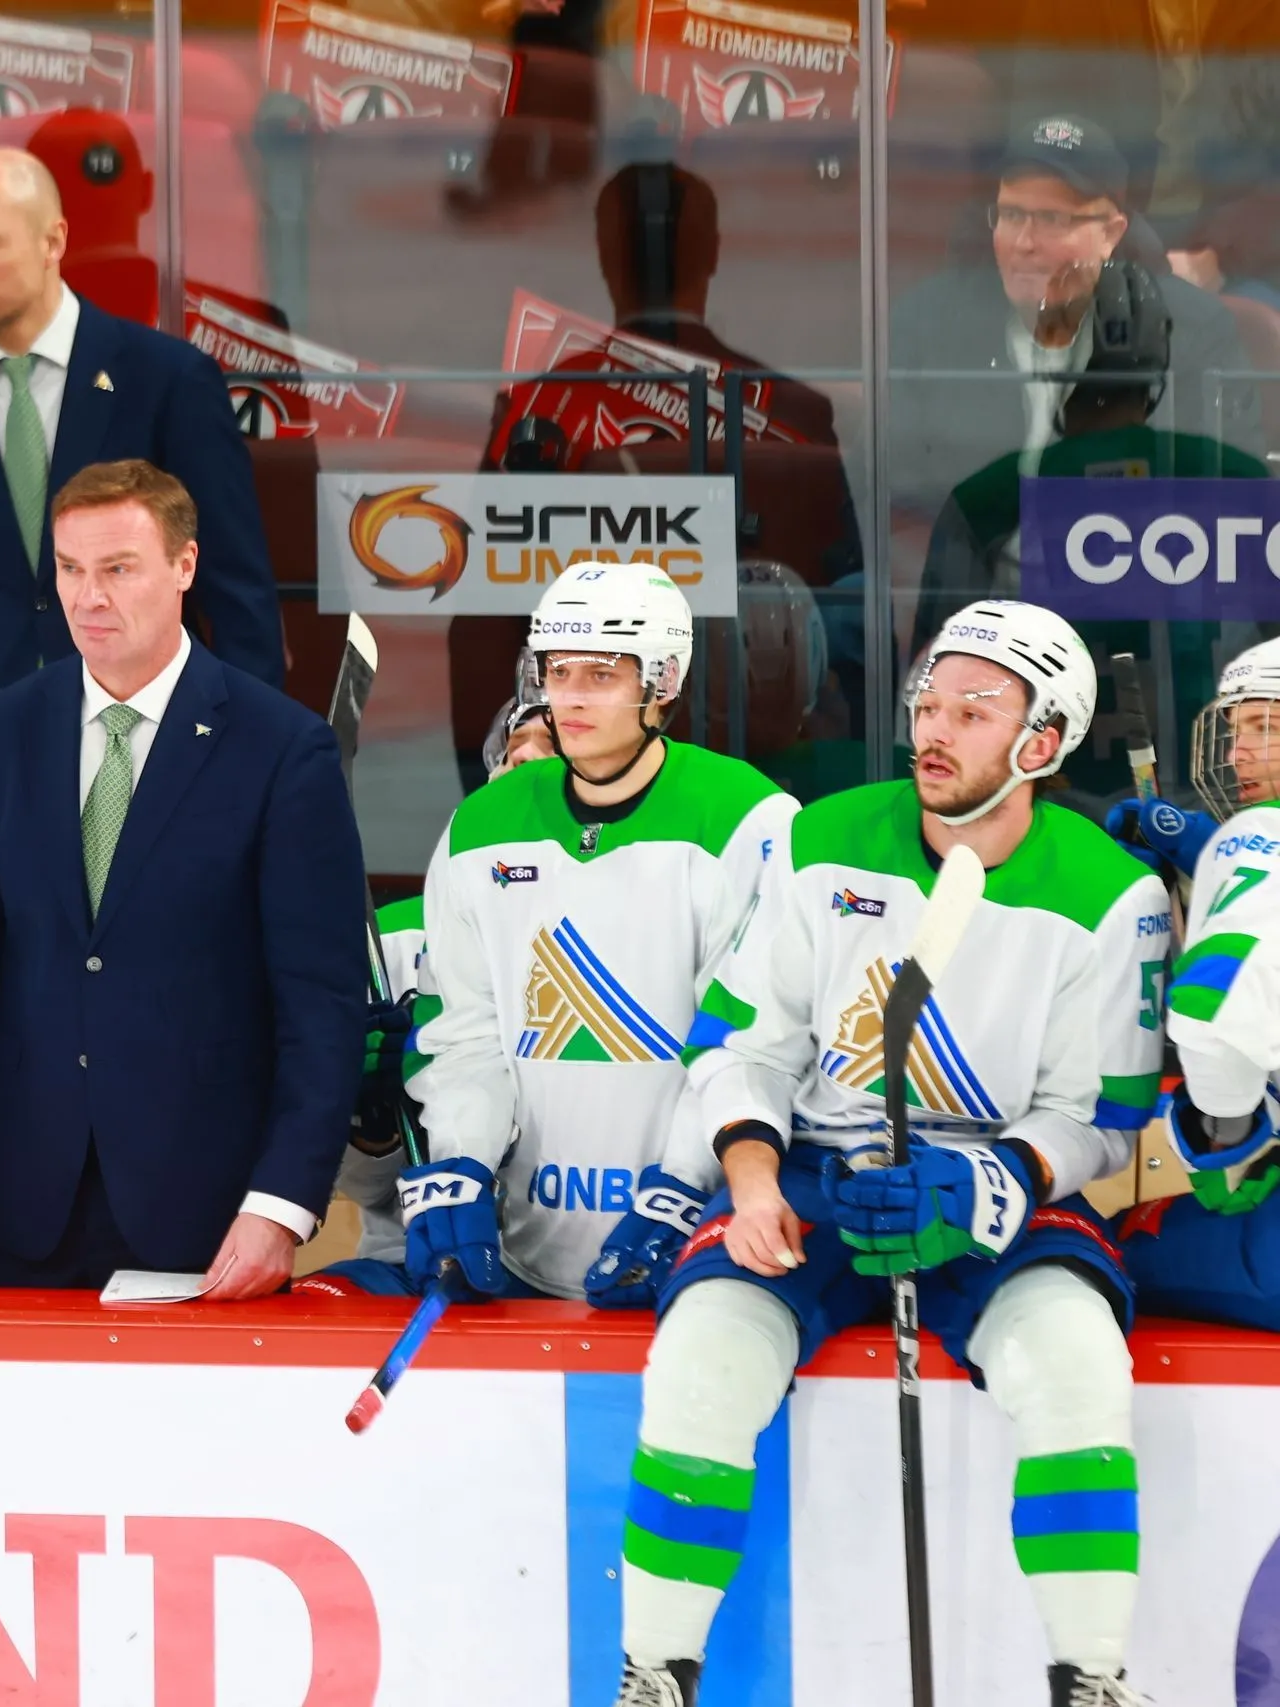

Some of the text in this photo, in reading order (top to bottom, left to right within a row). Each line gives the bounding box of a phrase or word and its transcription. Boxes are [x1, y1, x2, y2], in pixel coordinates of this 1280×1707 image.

[304, 28, 467, 92] АВТОМОБИЛИСТ
[681, 17, 848, 75] АВТОМОБИЛИСТ
[447, 151, 472, 172] 17
[816, 158, 840, 180] 16
[486, 505, 701, 545] УГМК
[667, 626, 691, 638] CCM
[1214, 832, 1280, 862] FONBE
[644, 1192, 704, 1227] CC
